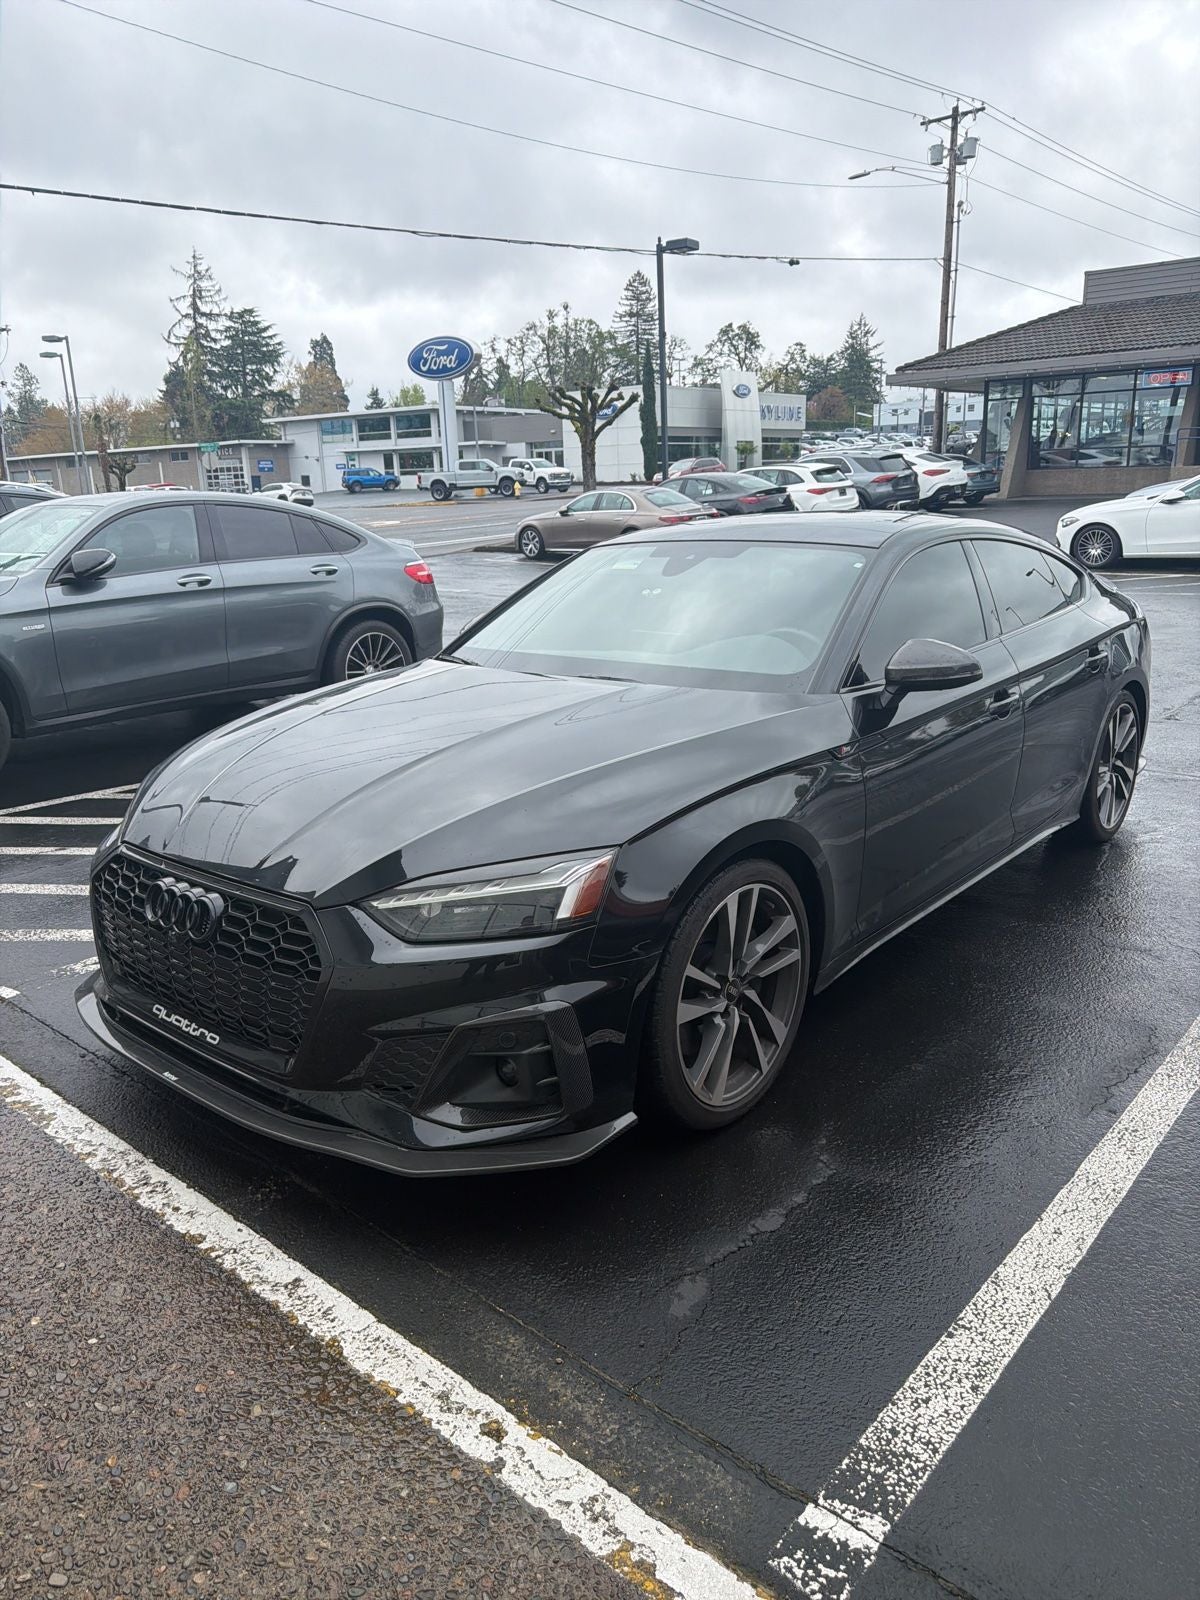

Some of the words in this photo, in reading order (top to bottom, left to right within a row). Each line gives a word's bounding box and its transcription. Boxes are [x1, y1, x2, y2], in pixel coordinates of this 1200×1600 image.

[420, 344, 458, 371] Ford
[1150, 371, 1188, 384] OPEN
[152, 1004, 220, 1045] quattro
